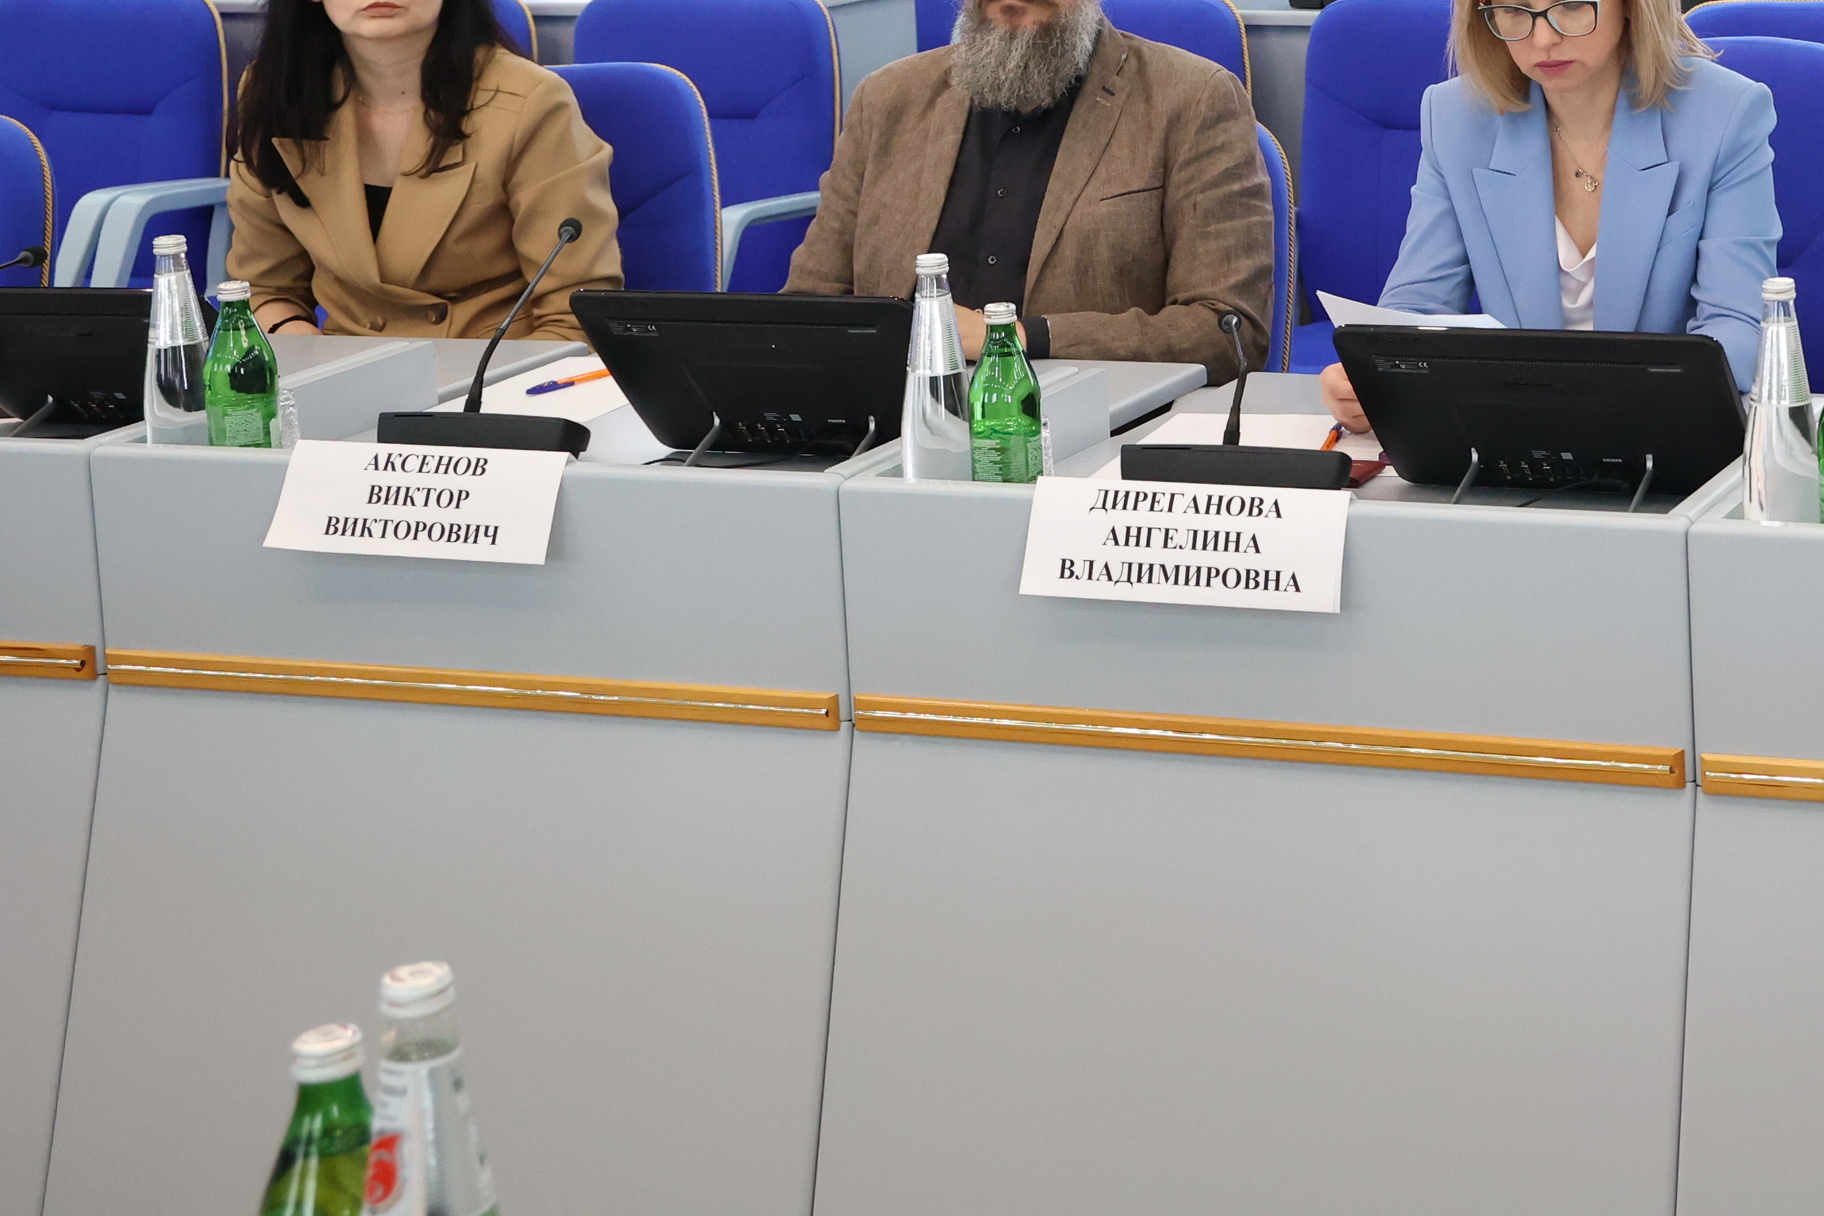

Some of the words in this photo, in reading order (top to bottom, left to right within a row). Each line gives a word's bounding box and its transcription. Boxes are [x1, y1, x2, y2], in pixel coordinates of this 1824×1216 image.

[363, 452, 489, 478] АКСЕНОВ
[366, 484, 470, 510] ВИКТОР
[1088, 488, 1284, 519] ДИРЕГАНОВА
[323, 515, 500, 546] ВИКТОРОВИЧ
[1102, 525, 1262, 554] АНГЕЛИНА
[1058, 558, 1302, 593] ВЛАДИМИРОВНА
